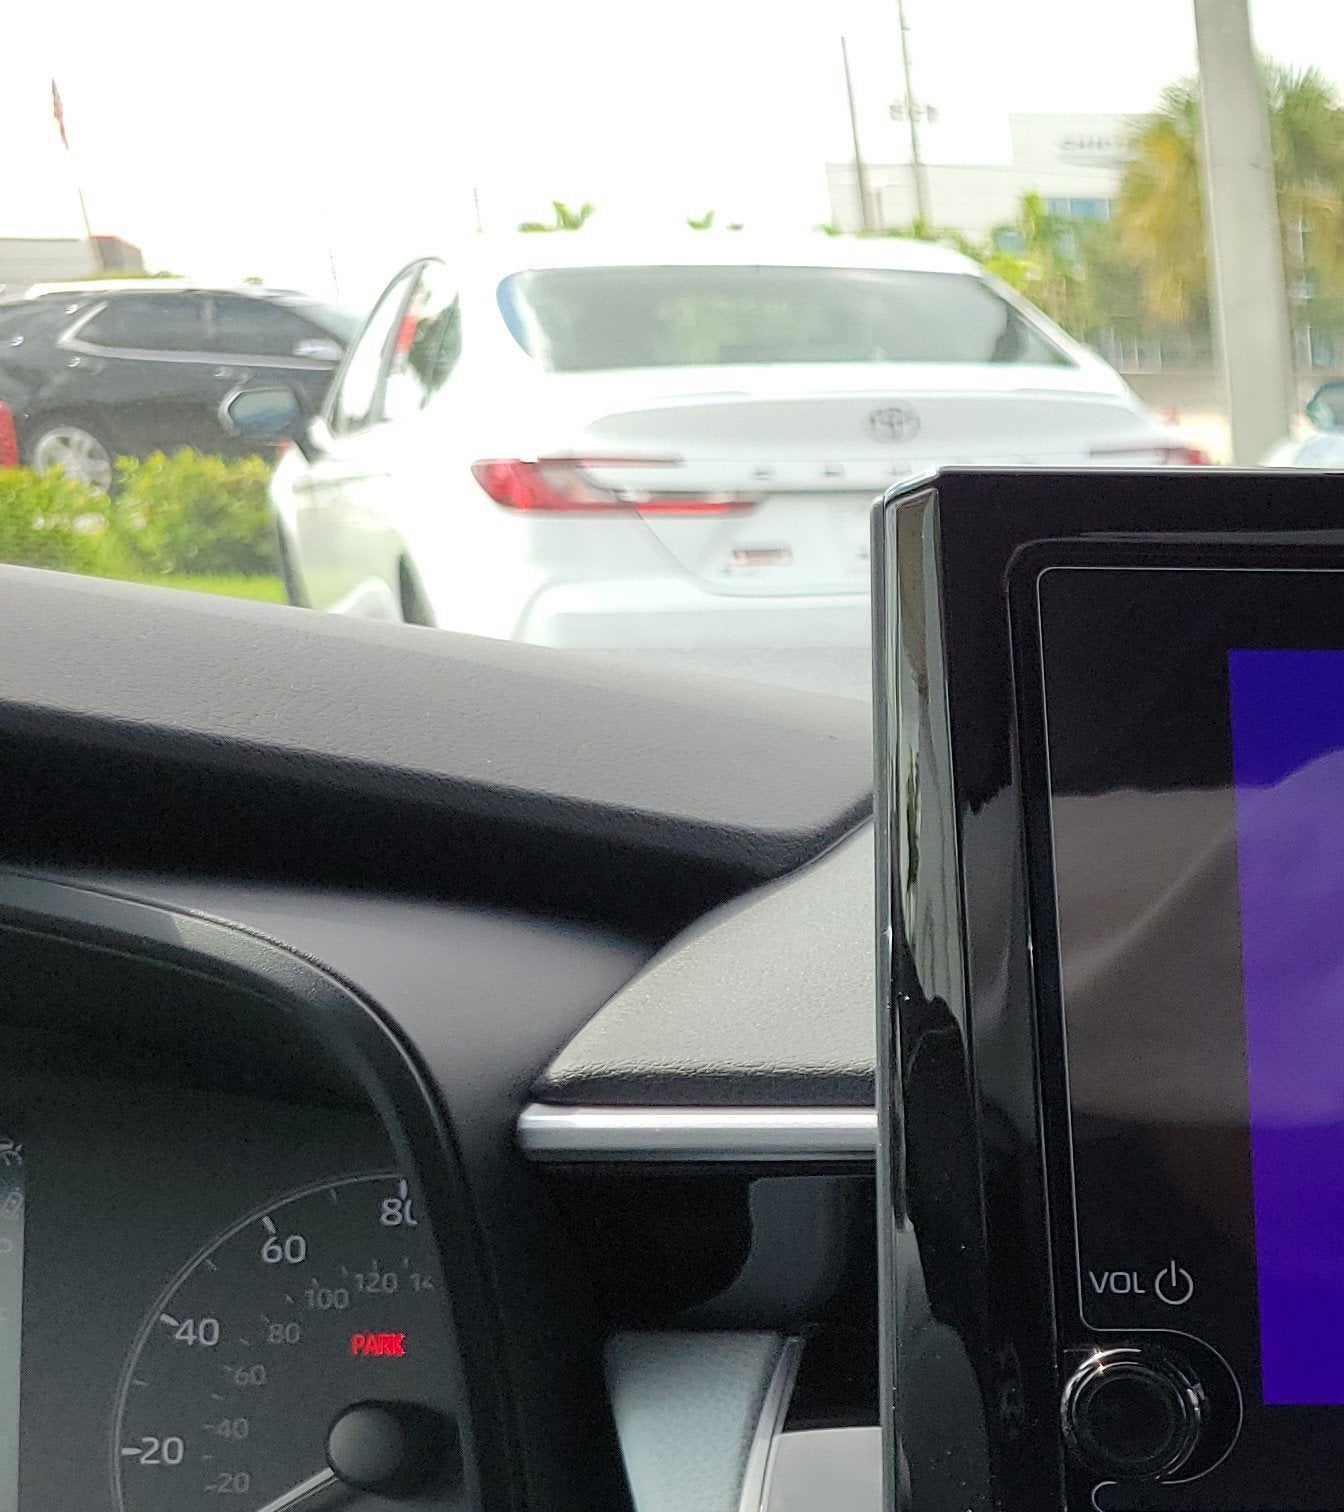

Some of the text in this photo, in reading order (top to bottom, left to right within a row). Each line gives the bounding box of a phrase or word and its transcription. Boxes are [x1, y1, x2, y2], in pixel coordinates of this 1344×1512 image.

[262, 1236, 306, 1265] 60
[354, 1272, 399, 1293] 120
[410, 1272, 435, 1293] 14
[1089, 1271, 1146, 1294] VOL
[304, 1288, 349, 1310] 100
[175, 1317, 219, 1346] 40
[269, 1323, 300, 1345] 80
[351, 1333, 406, 1356] PARK
[235, 1364, 266, 1387] 60
[216, 1417, 249, 1440] 40
[140, 1437, 184, 1467] 20
[218, 1472, 250, 1494] 20
